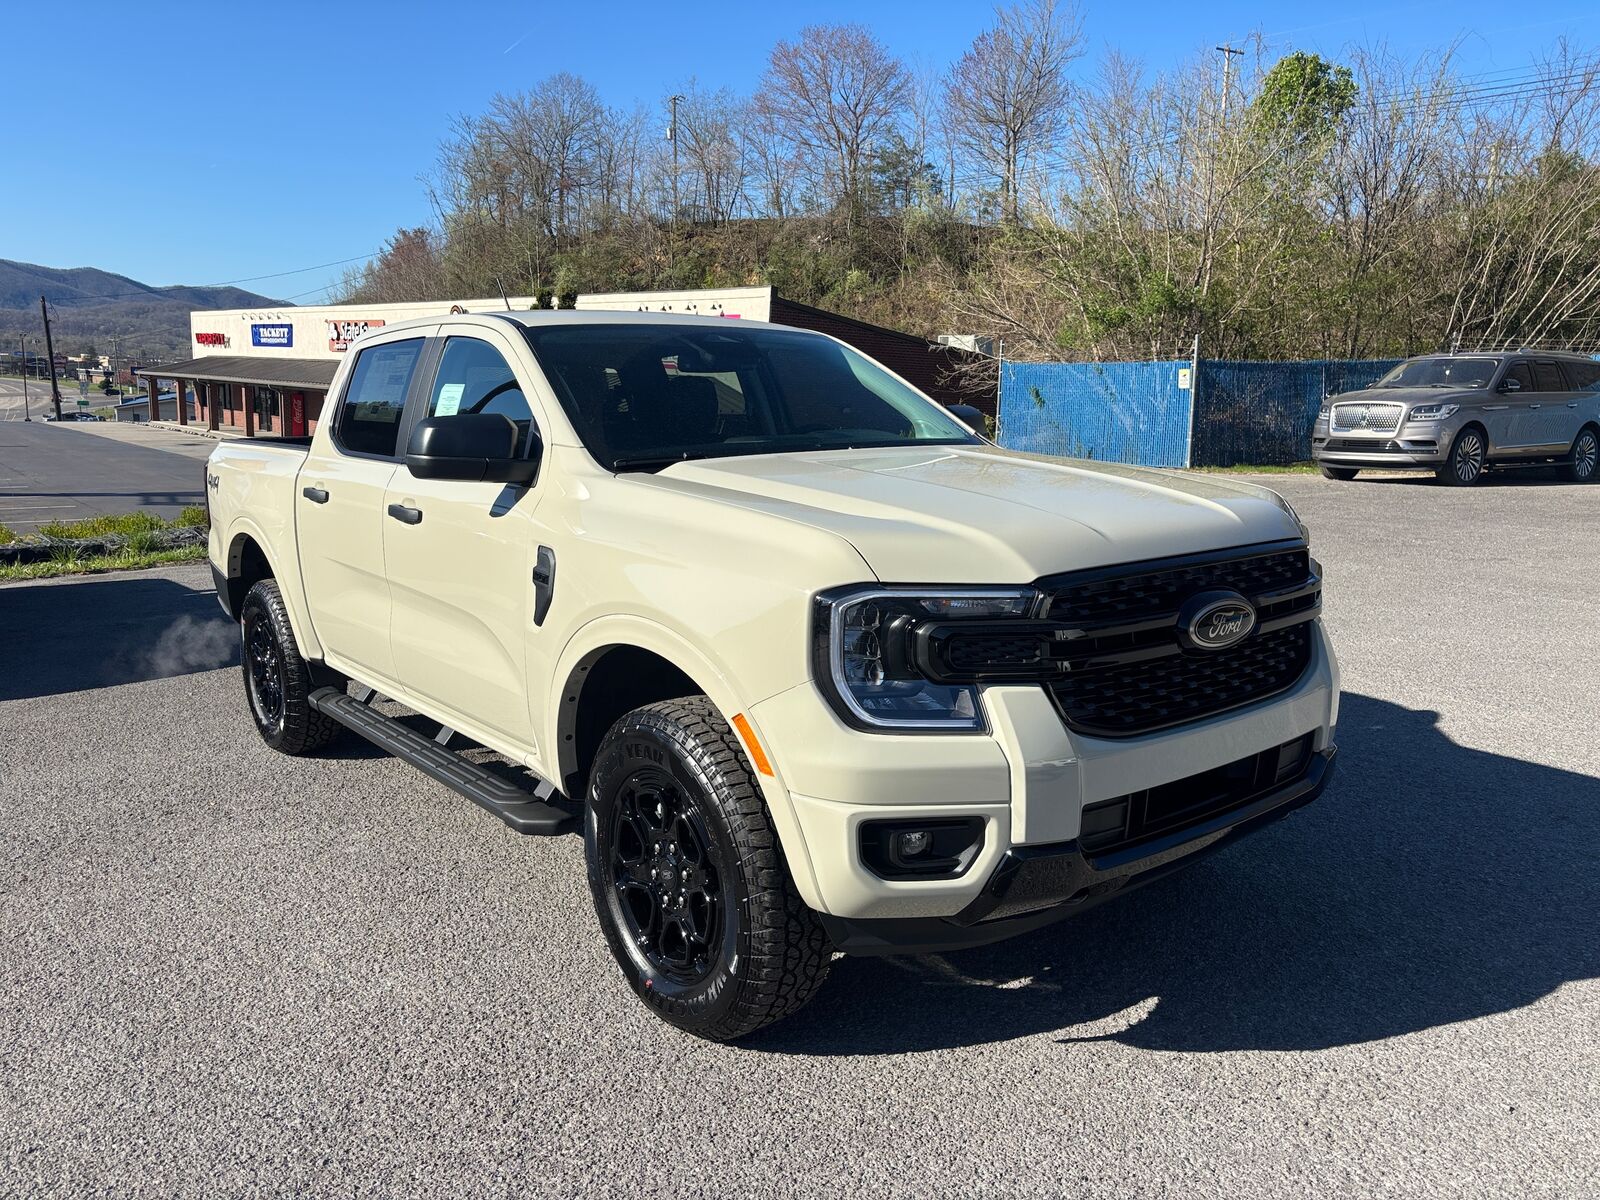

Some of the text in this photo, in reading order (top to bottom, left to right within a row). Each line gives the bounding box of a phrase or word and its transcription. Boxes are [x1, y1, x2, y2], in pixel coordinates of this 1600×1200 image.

[259, 327, 289, 338] TACKETT
[340, 321, 360, 340] State
[1208, 610, 1244, 638] Ford
